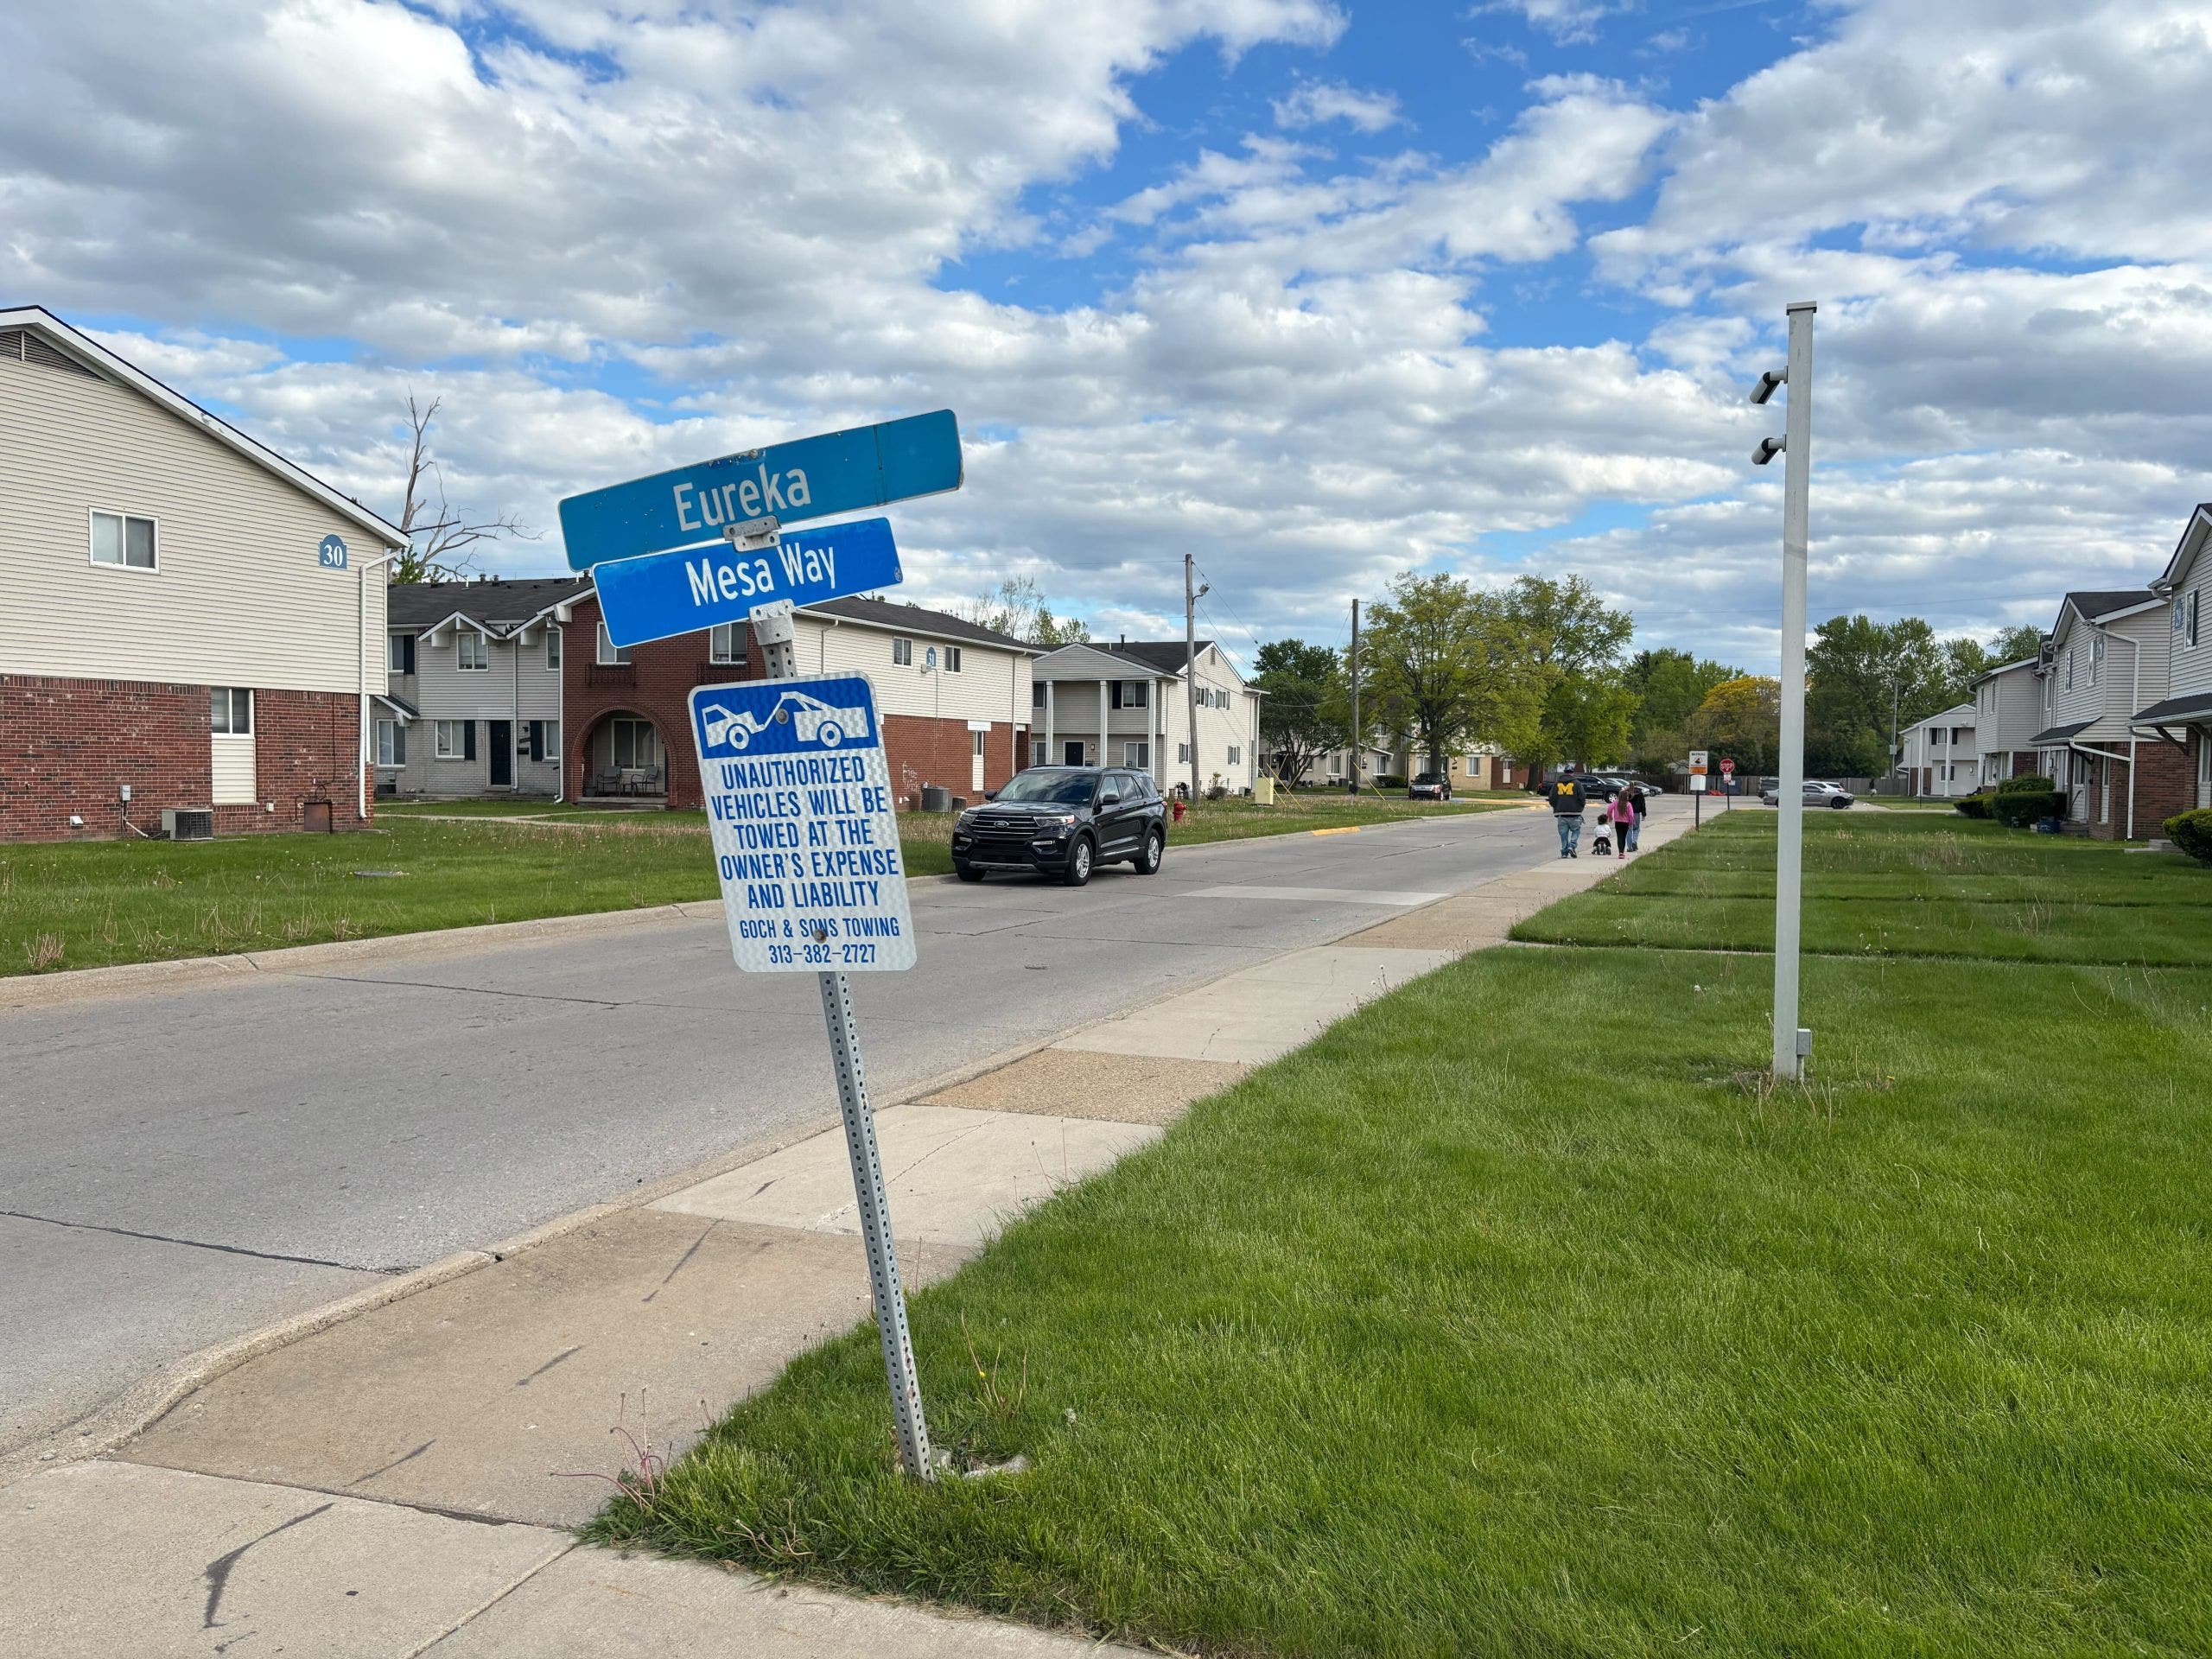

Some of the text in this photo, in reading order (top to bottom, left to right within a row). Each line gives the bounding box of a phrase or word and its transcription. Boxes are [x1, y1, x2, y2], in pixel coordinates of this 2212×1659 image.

[673, 464, 810, 531] Eureka
[323, 544, 343, 566] 30
[685, 542, 836, 607] Mesa Way
[928, 652, 934, 665] 31
[721, 756, 865, 790] UNAUTHORIZED
[711, 786, 887, 820] VEHICLES WILL BE
[1557, 782, 1574, 796] M
[734, 819, 874, 849] TOWED AT THE
[720, 849, 899, 880] OWNER'S EXPENSE
[748, 881, 879, 908] AND LIABILITY
[740, 918, 899, 938] GOCH & SONS TOWING
[768, 944, 876, 963] 313-382-2727
